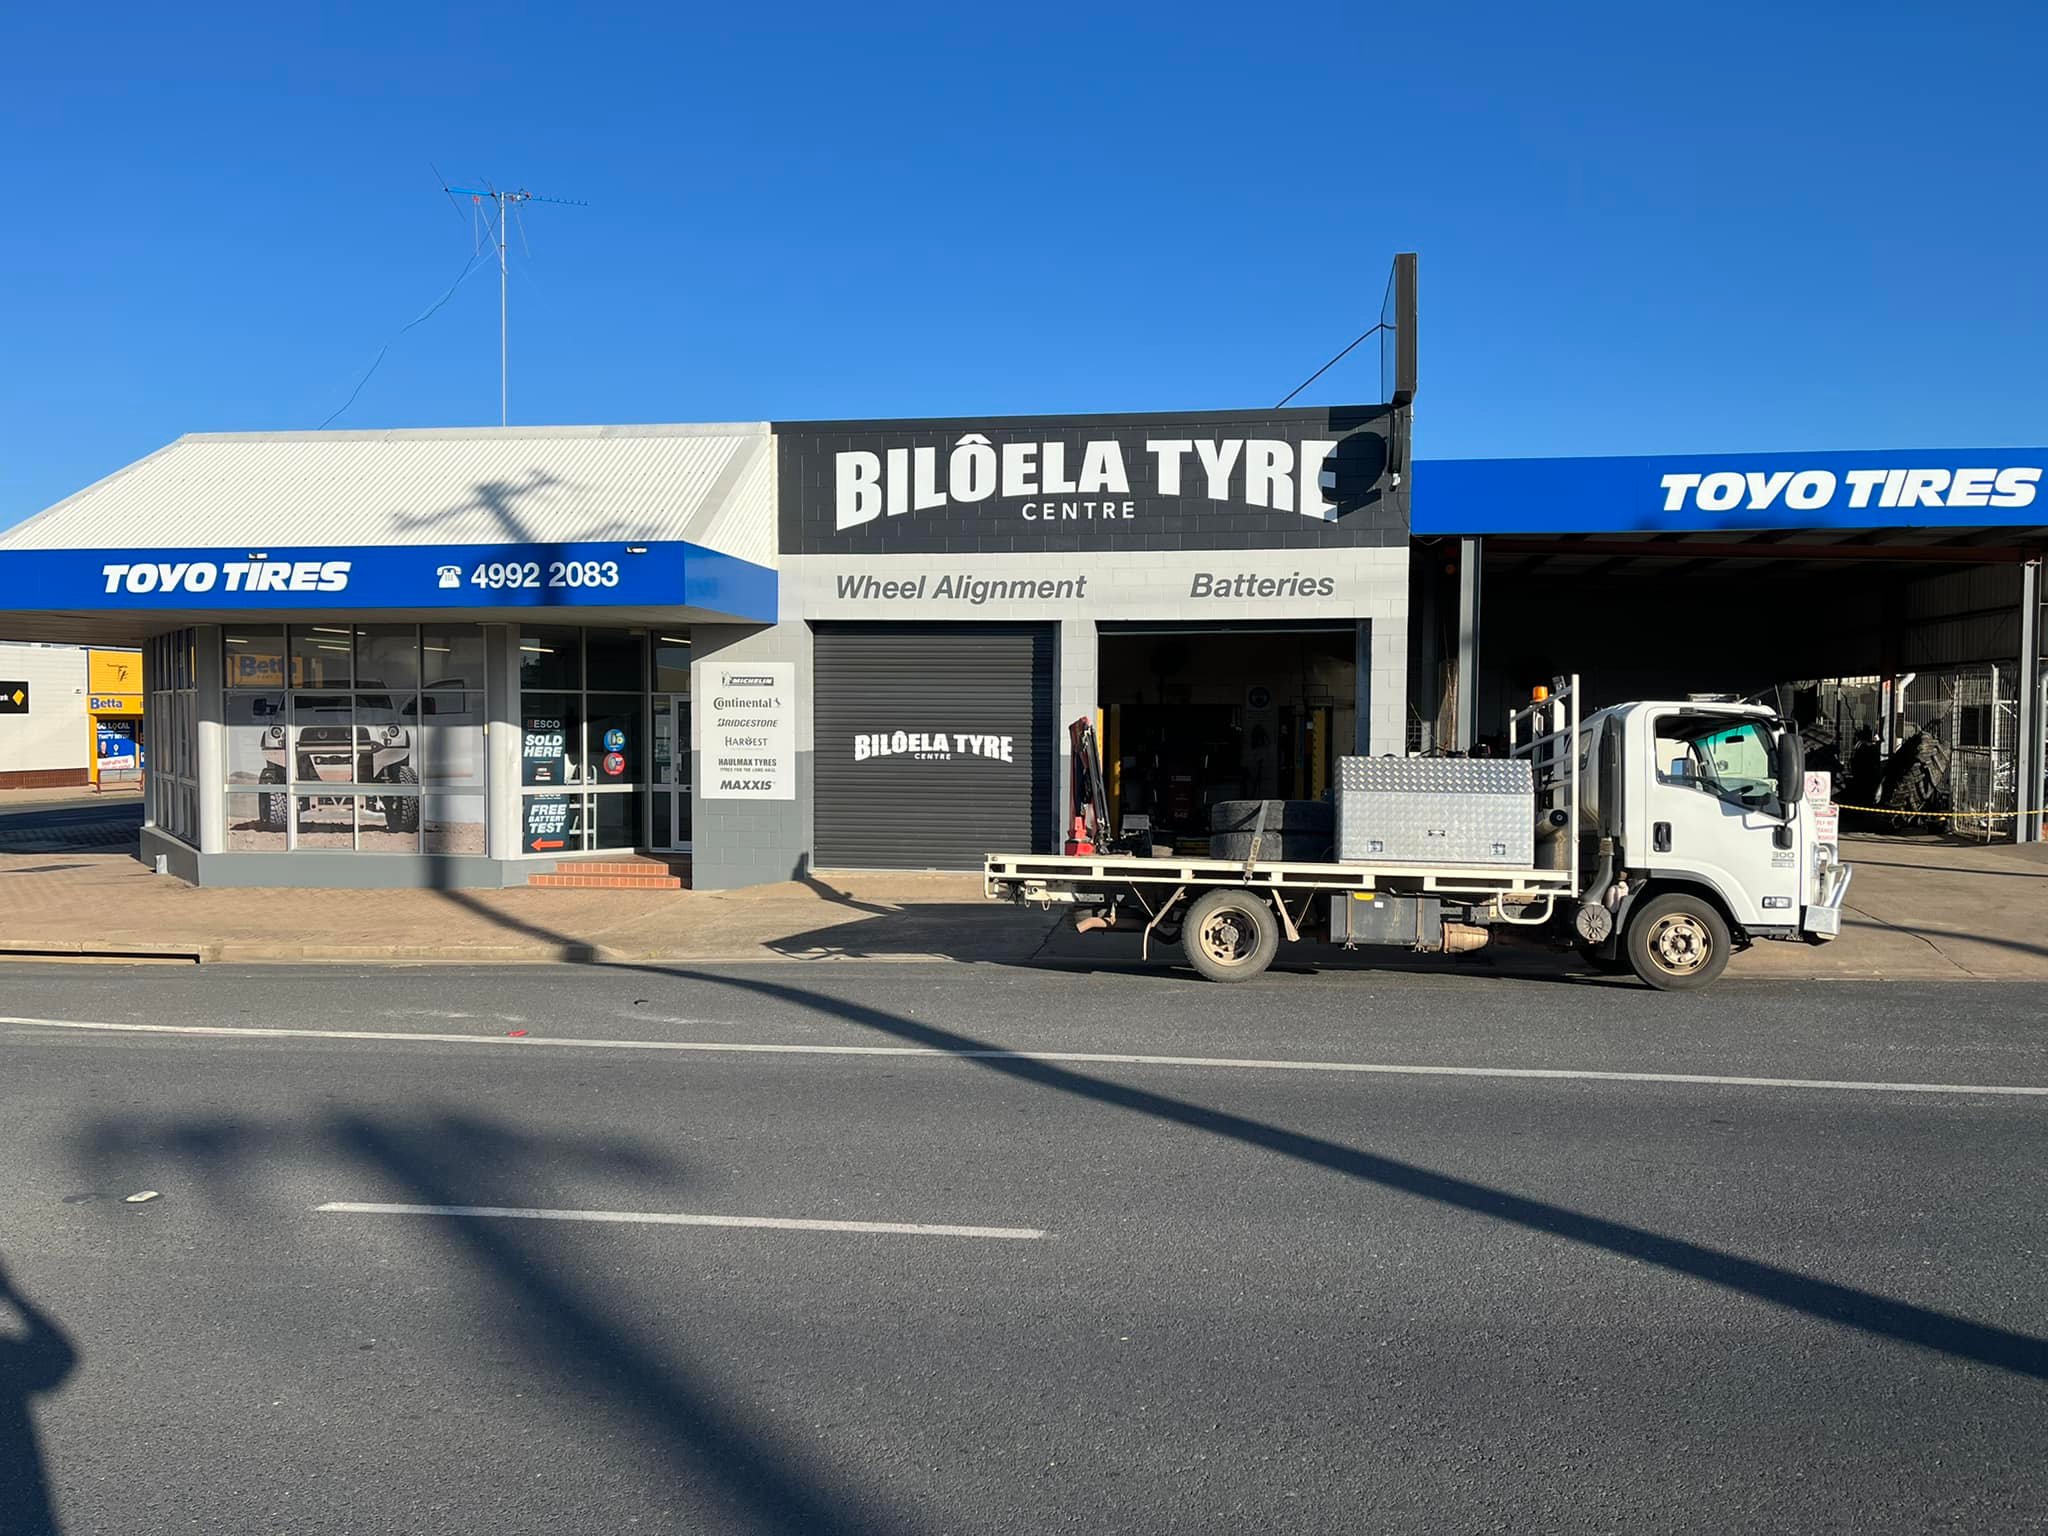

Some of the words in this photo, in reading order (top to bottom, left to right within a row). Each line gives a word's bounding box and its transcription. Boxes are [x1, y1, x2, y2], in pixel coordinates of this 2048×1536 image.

[836, 433, 1130, 531] BILÔELA
[1146, 439, 1338, 523] TYRE
[1660, 470, 1837, 511] TOYO
[1845, 467, 2043, 508] TIRES
[1022, 501, 1135, 521] CENTRE
[102, 563, 217, 593] TOYO
[222, 561, 352, 592] TIRES
[471, 563, 540, 589] 4992
[549, 561, 619, 587] 2083
[837, 575, 926, 599] Wheel
[932, 575, 1087, 605] Alignment
[1190, 572, 1335, 597] Batteries
[731, 677, 773, 686] MICHELIN
[90, 698, 122, 709] Betta
[713, 697, 771, 710] Continental
[717, 718, 779, 727] BRIDGESTONE
[525, 734, 562, 746] SOLD
[725, 736, 768, 747] HARVEST
[523, 746, 562, 757] HERE
[953, 734, 1013, 763] TYRE
[718, 758, 753, 767] HAULMAX
[754, 758, 777, 767] TYRES
[720, 780, 772, 790] MAXXIS
[531, 804, 567, 815] FREE
[528, 815, 567, 823] BATTERY
[530, 822, 564, 833] TEST
